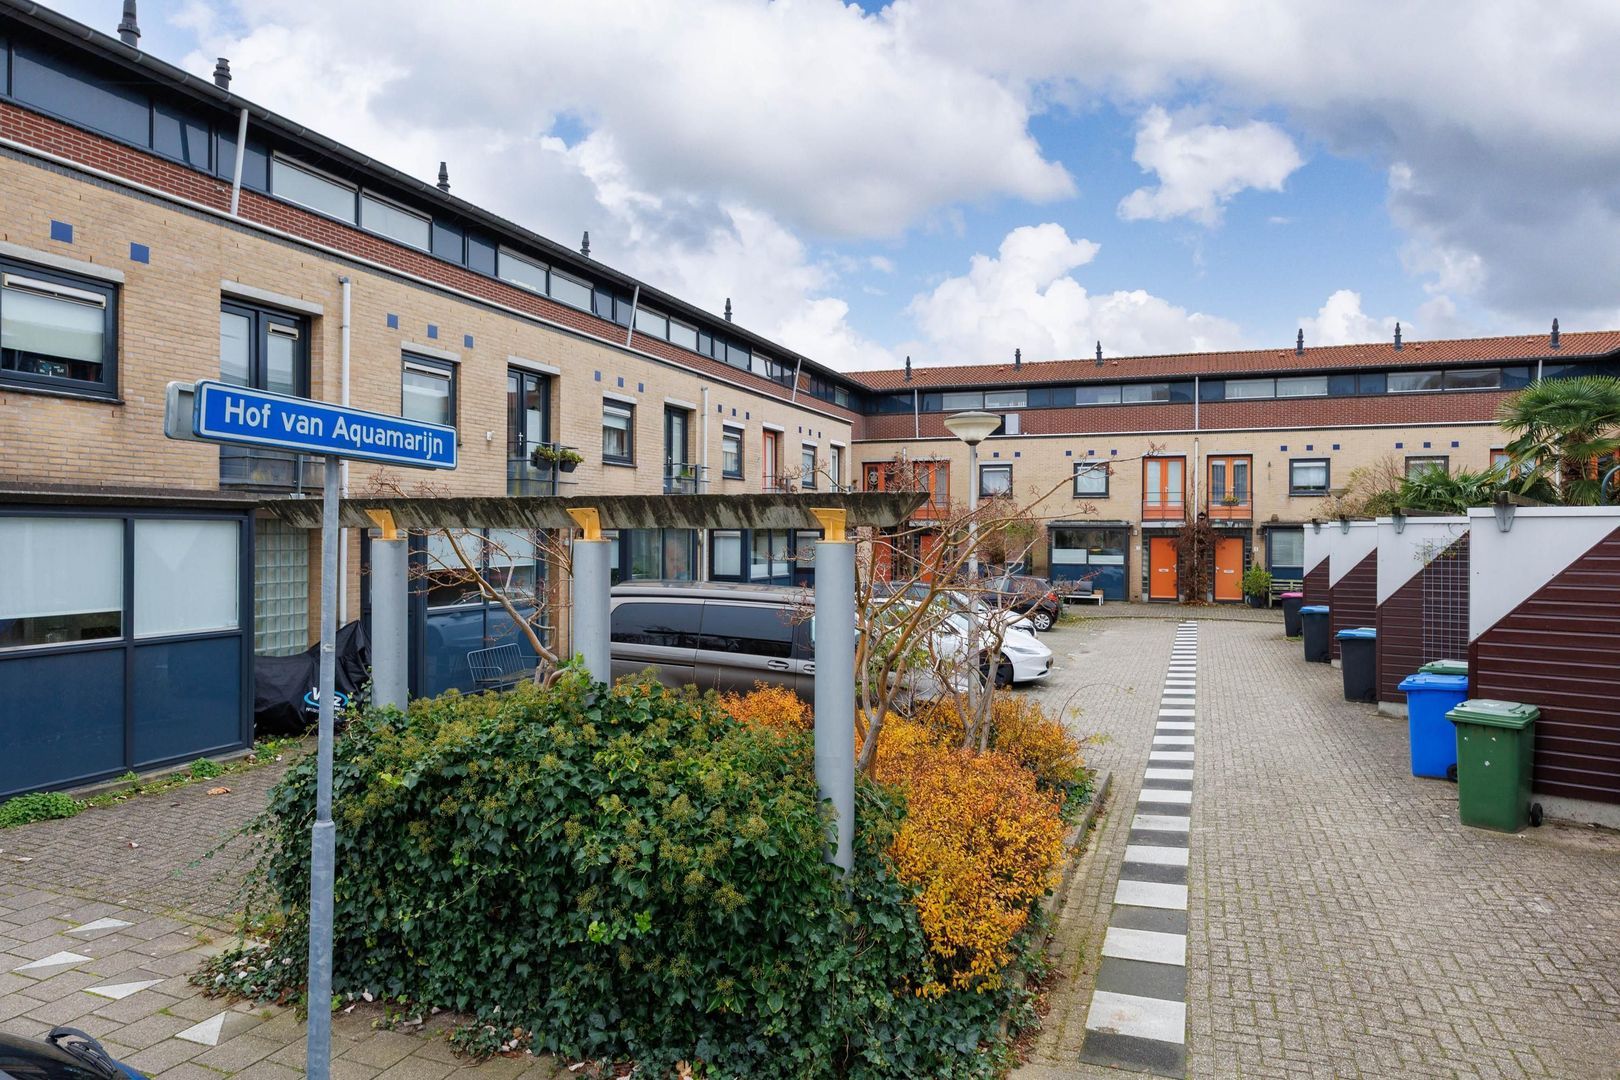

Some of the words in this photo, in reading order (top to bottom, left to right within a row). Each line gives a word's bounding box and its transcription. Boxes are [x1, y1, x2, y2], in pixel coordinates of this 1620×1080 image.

[225, 396, 271, 428] Hof
[281, 412, 323, 437] van
[332, 416, 443, 459] Aquamarijn
